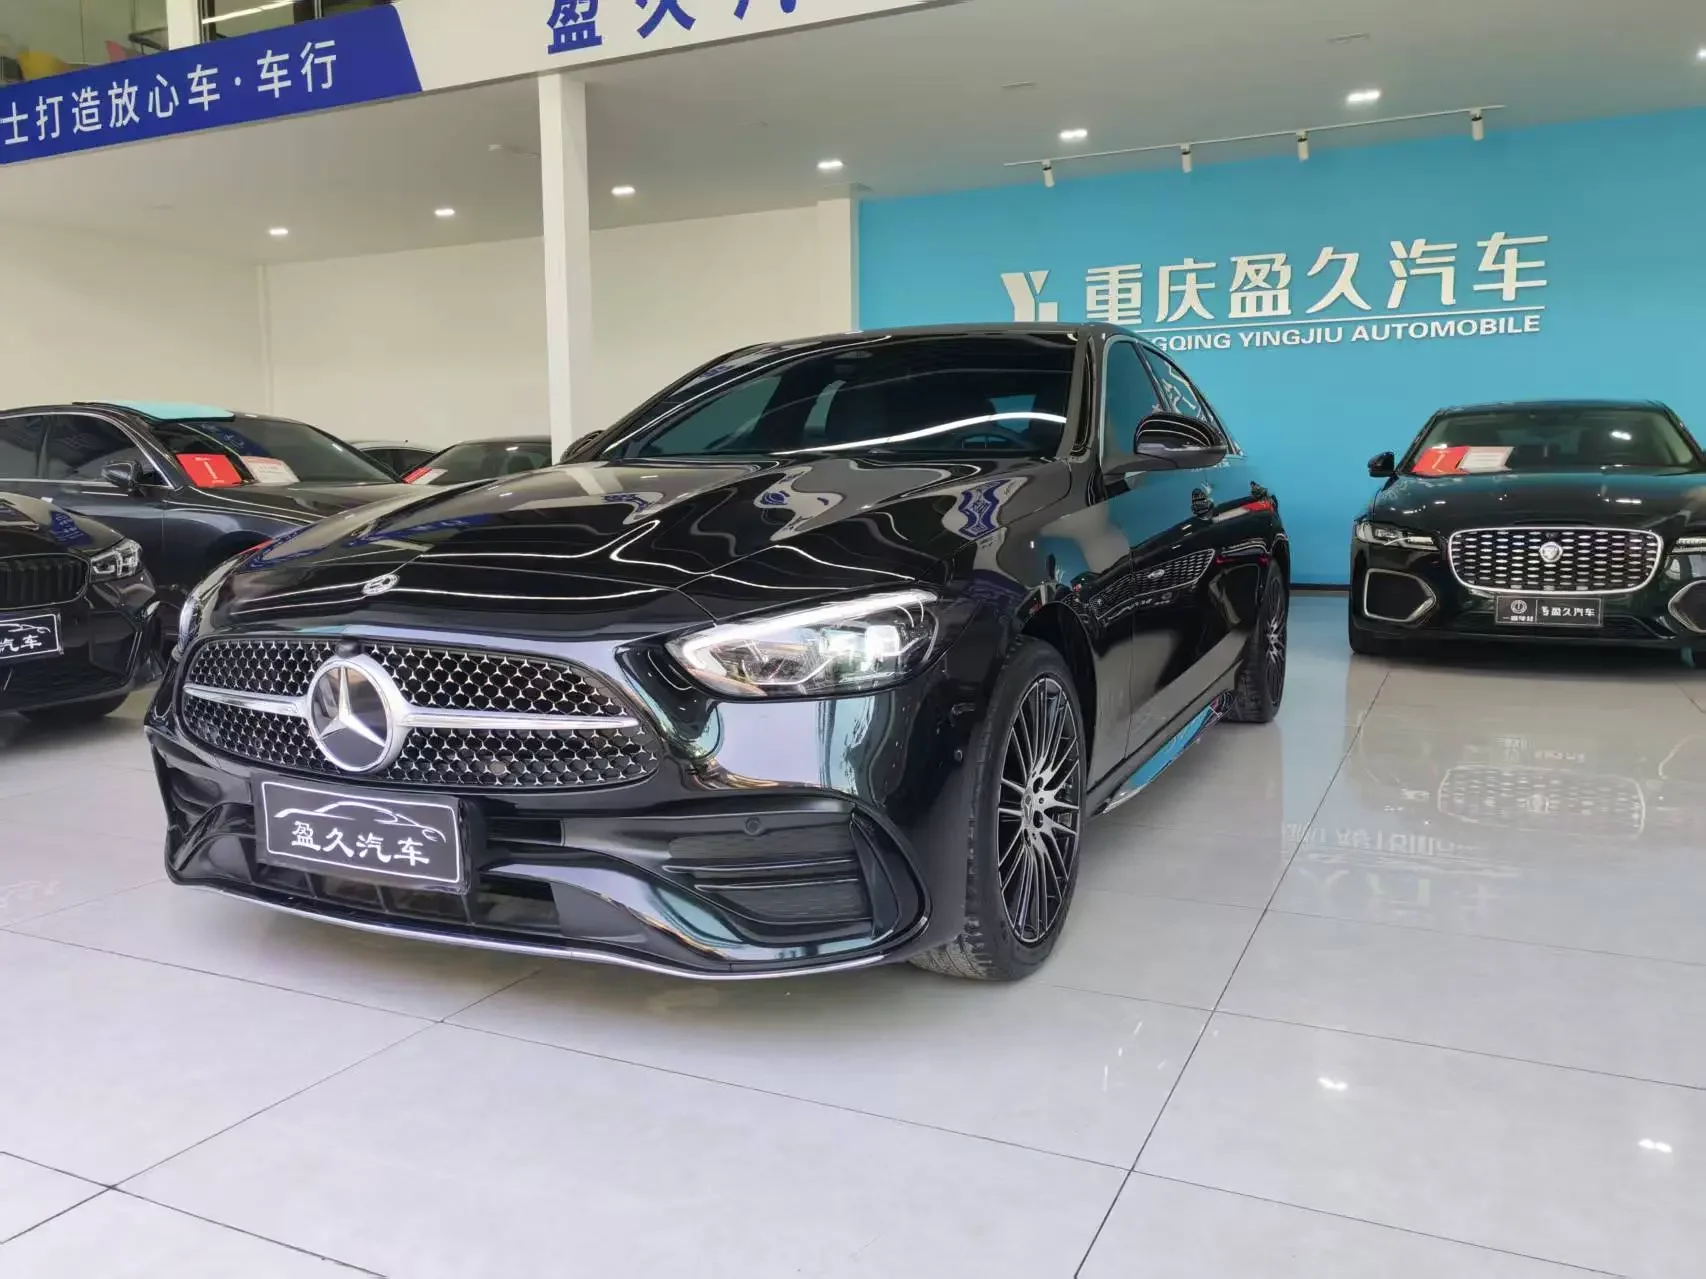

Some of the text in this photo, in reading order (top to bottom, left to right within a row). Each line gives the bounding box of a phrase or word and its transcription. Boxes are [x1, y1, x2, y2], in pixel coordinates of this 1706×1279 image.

[546, 0, 798, 55] 盈久
[1085, 231, 1549, 325] 重庆盈久汽车
[1152, 314, 1541, 351] GQING YINGJIU AUTOMOBILE
[291, 820, 431, 867] 盈久汽车
